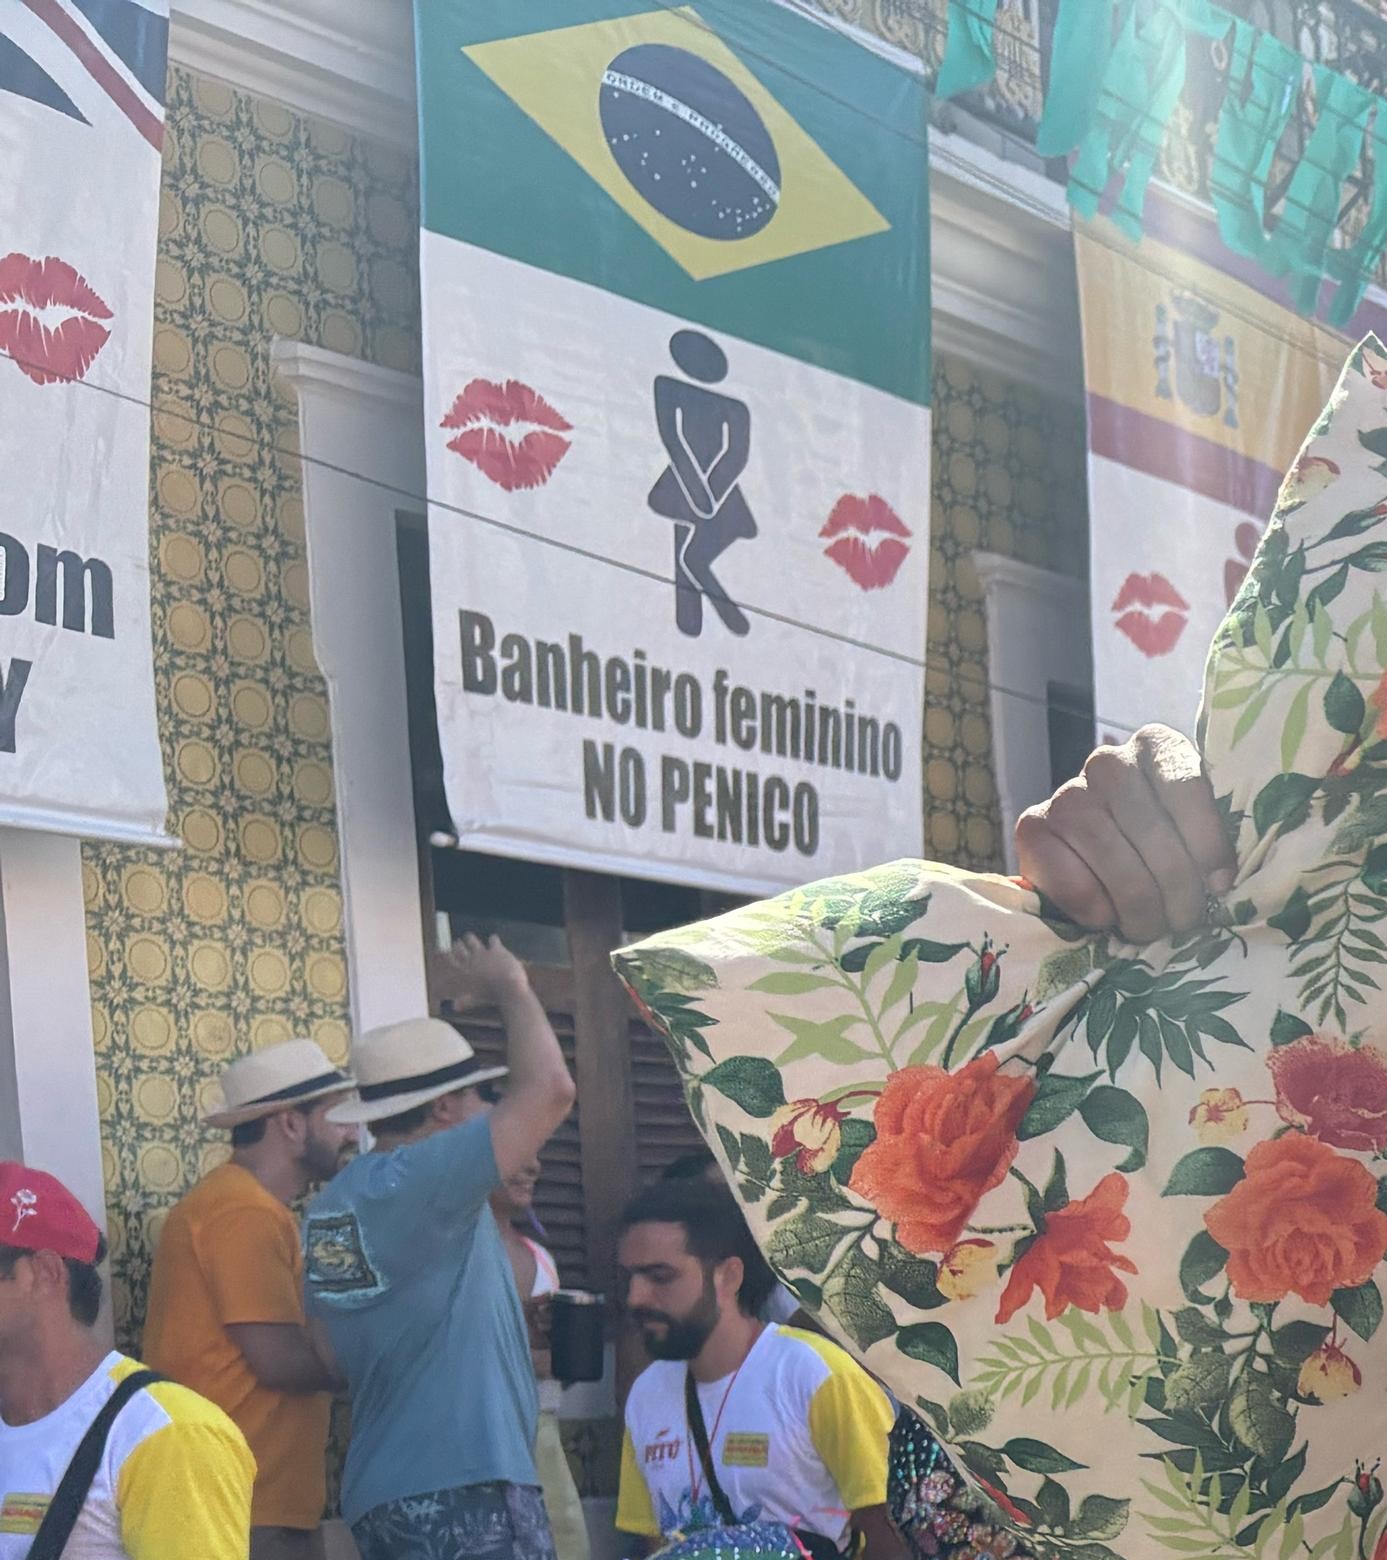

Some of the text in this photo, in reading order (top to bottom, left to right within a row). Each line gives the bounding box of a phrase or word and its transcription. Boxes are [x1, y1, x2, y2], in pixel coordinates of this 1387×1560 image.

[459, 609, 903, 782] Banheiro feminino
[583, 739, 820, 857] NO PENICO
